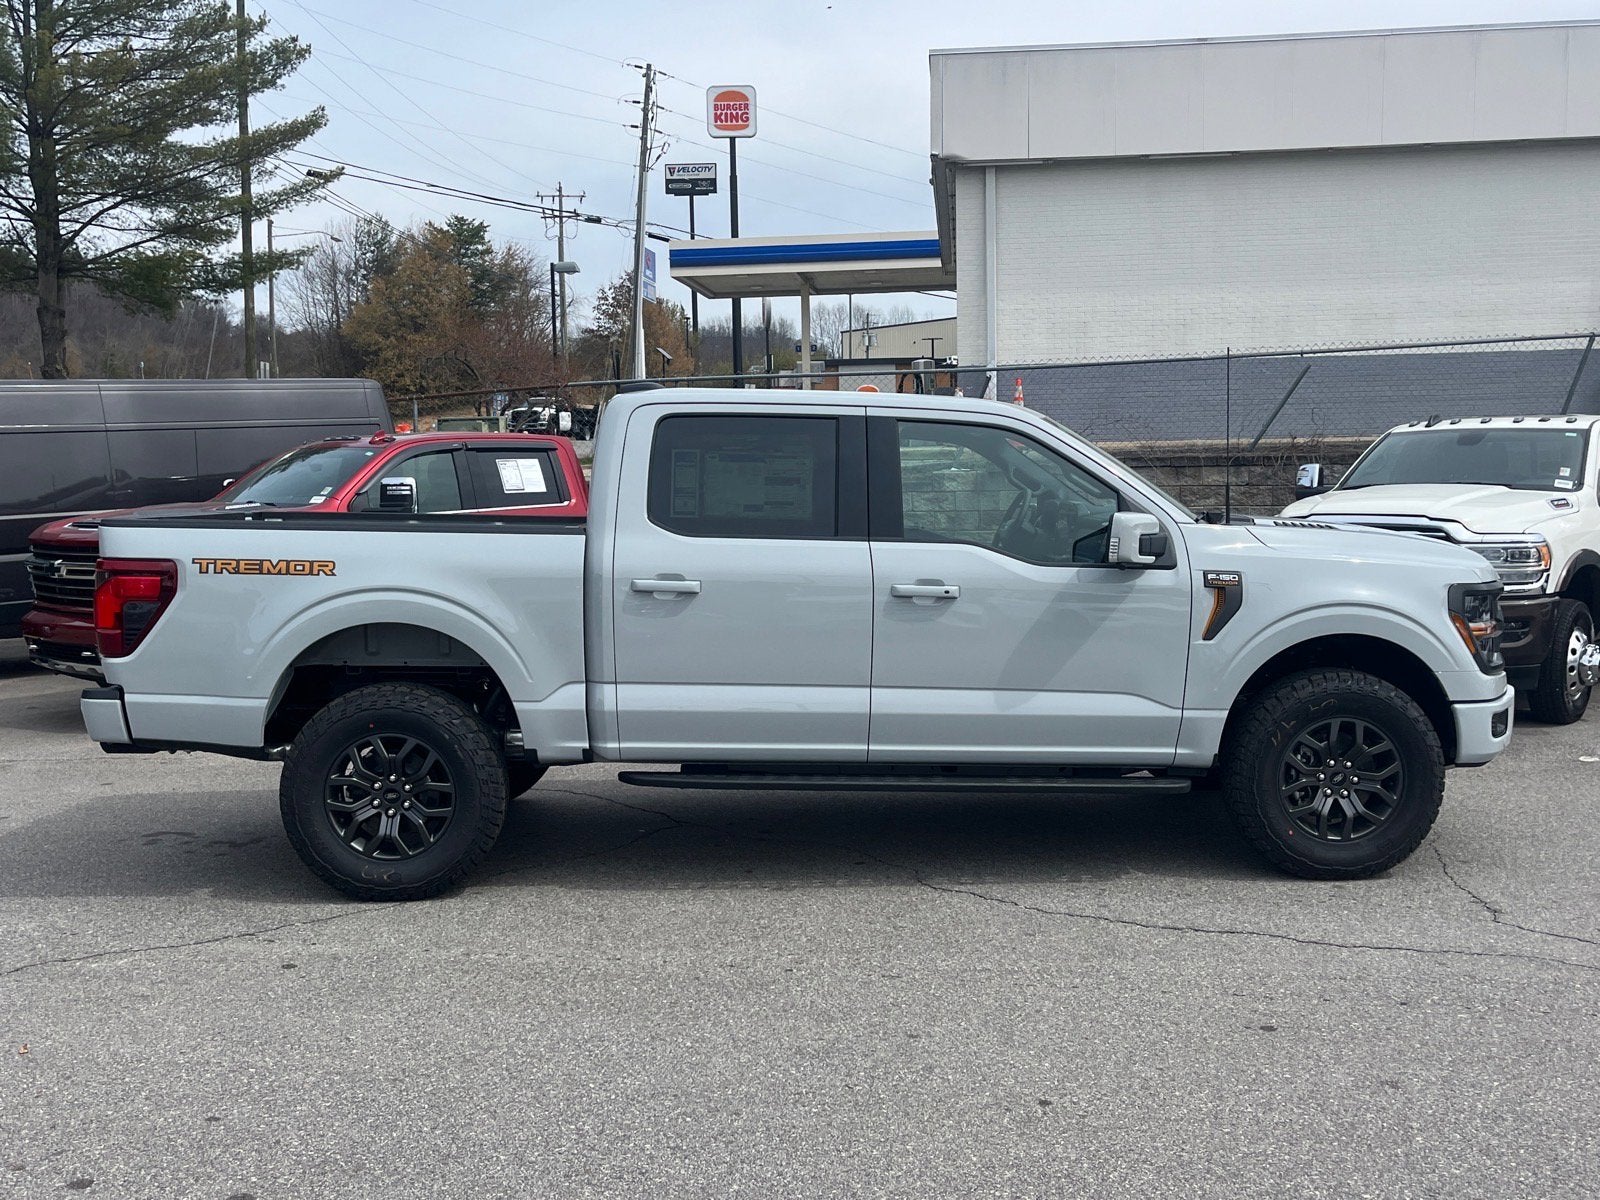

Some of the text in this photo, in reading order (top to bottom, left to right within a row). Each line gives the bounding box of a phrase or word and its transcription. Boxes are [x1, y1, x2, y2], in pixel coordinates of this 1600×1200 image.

[714, 103, 749, 111] BURGER
[714, 112, 749, 123] KING
[192, 558, 337, 576] TREMOR
